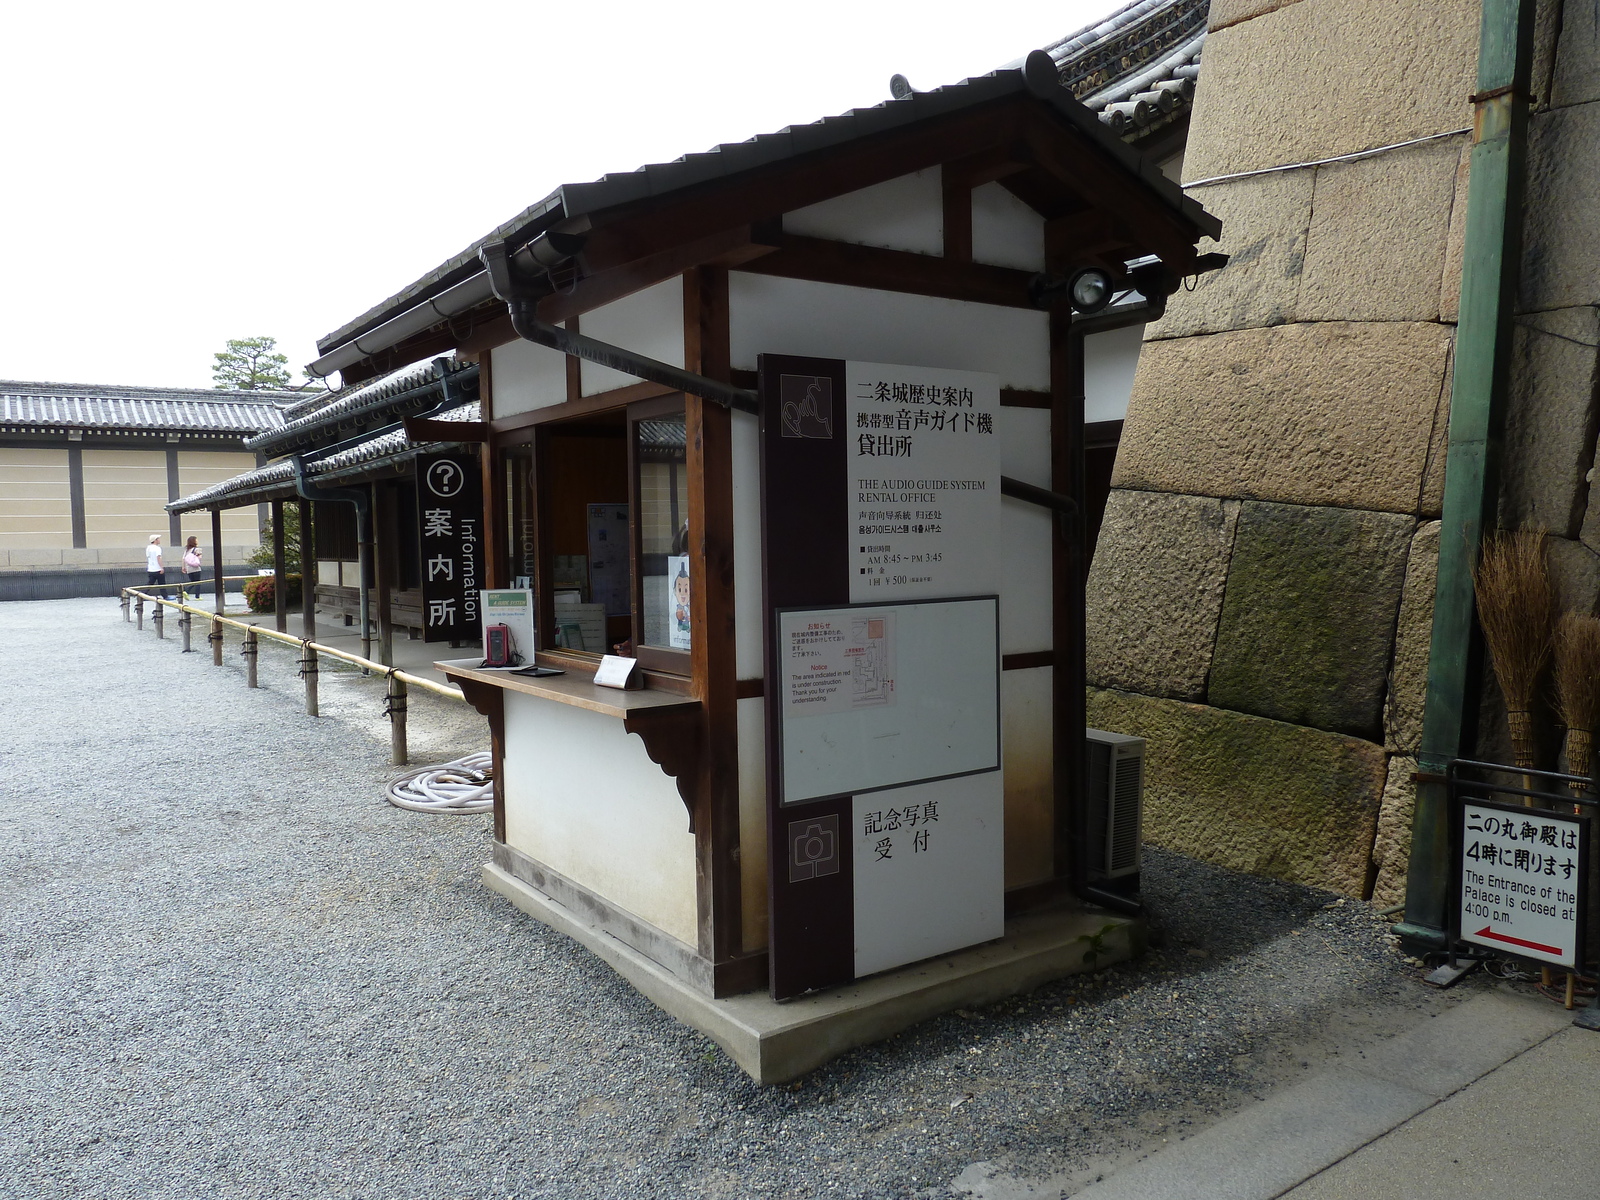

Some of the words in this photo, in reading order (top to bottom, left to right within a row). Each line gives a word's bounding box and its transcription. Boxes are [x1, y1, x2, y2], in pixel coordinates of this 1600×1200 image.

[857, 381, 973, 408] 二条城歴史案内
[857, 408, 993, 435] 携帯型音声ガイド機
[857, 434, 913, 458] 貸出所
[858, 479, 879, 490] THE
[881, 479, 915, 490] AUDIO
[916, 480, 949, 490] GUIDE
[950, 480, 986, 490] SYSTEM
[858, 492, 899, 503] RENTAL
[900, 492, 936, 503] OFFICE
[867, 545, 891, 553] 貸出時間
[868, 556, 881, 565] AM
[883, 554, 901, 564] 8:45
[911, 555, 923, 563] PM
[925, 553, 942, 562] 3:45
[424, 507, 456, 628] 案内所
[461, 518, 478, 622] Information
[808, 623, 831, 631] お知らせ
[792, 689, 808, 697] Thank
[808, 688, 818, 696] you
[863, 800, 939, 836] 記念写真
[1466, 813, 1578, 850] 二の丸御殿は
[1465, 840, 1576, 880] 4時に閉ります
[1465, 869, 1484, 885] The
[1488, 874, 1536, 896] Entrance
[1540, 887, 1553, 900] of
[1556, 888, 1576, 904] the
[1464, 885, 1501, 905] Palace
[1505, 894, 1515, 908] is
[1520, 898, 1556, 917] closed
[1561, 907, 1575, 921] at
[1464, 902, 1489, 918] 4:00
[1493, 909, 1513, 925] p.m.
